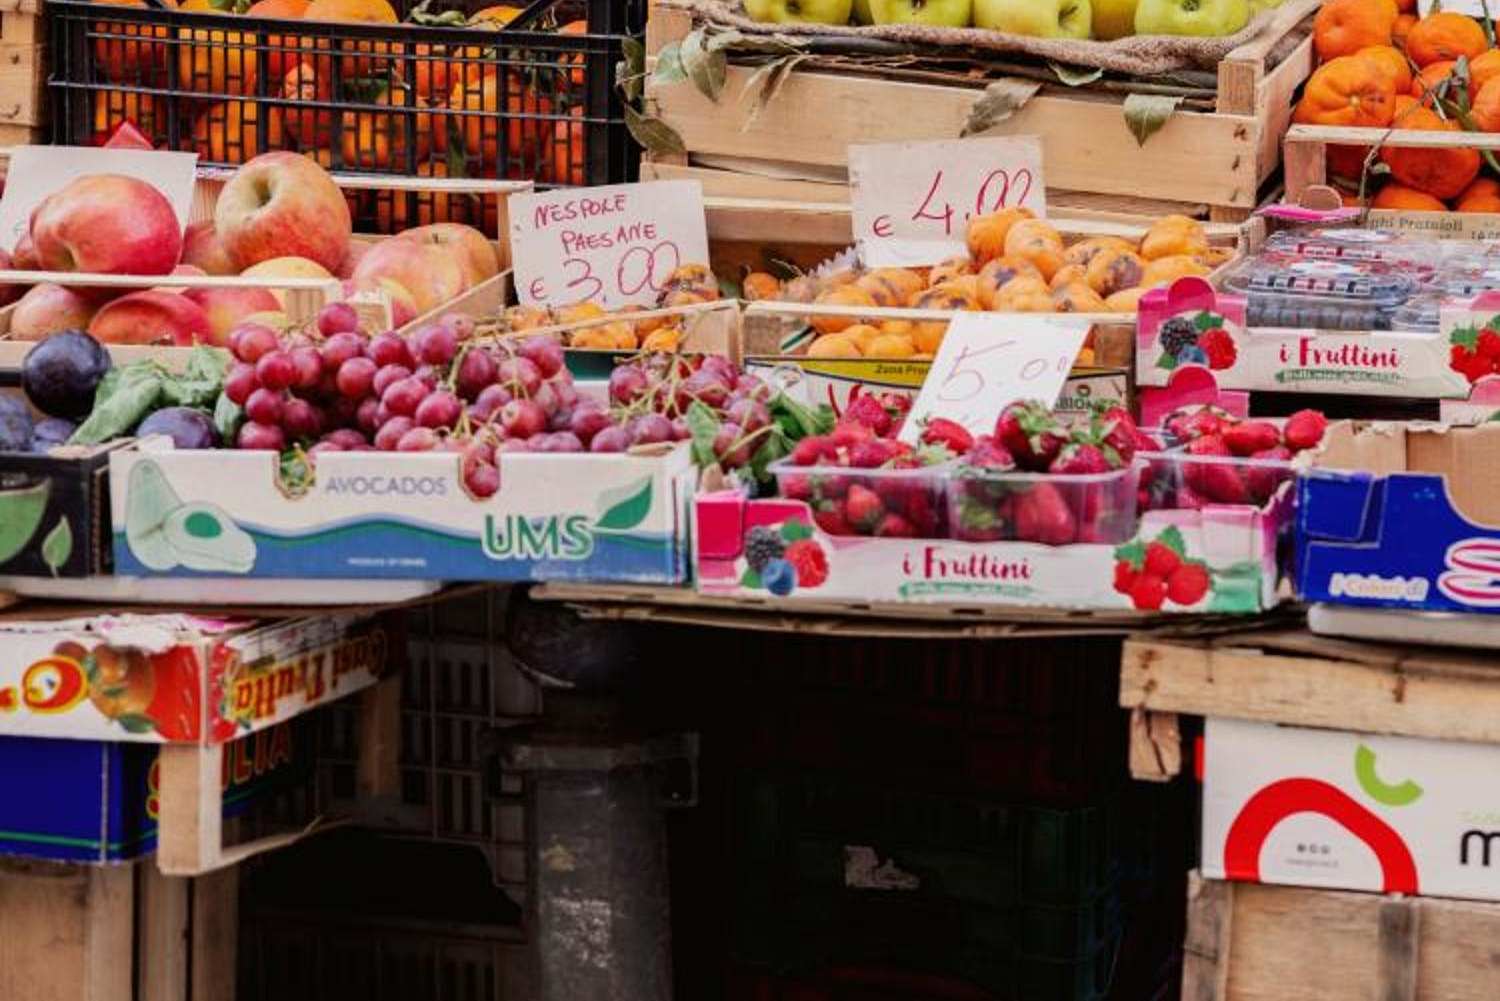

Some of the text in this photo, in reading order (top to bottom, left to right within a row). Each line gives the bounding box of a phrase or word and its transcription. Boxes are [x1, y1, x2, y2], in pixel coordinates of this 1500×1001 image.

[534, 193, 628, 229] NESPOLE
[559, 222, 658, 255] PAESANE
[1299, 337, 1400, 368] Fruttini
[325, 476, 447, 496] AVOCADOS
[484, 514, 594, 558] UMS
[924, 546, 1032, 579] Fruttini
